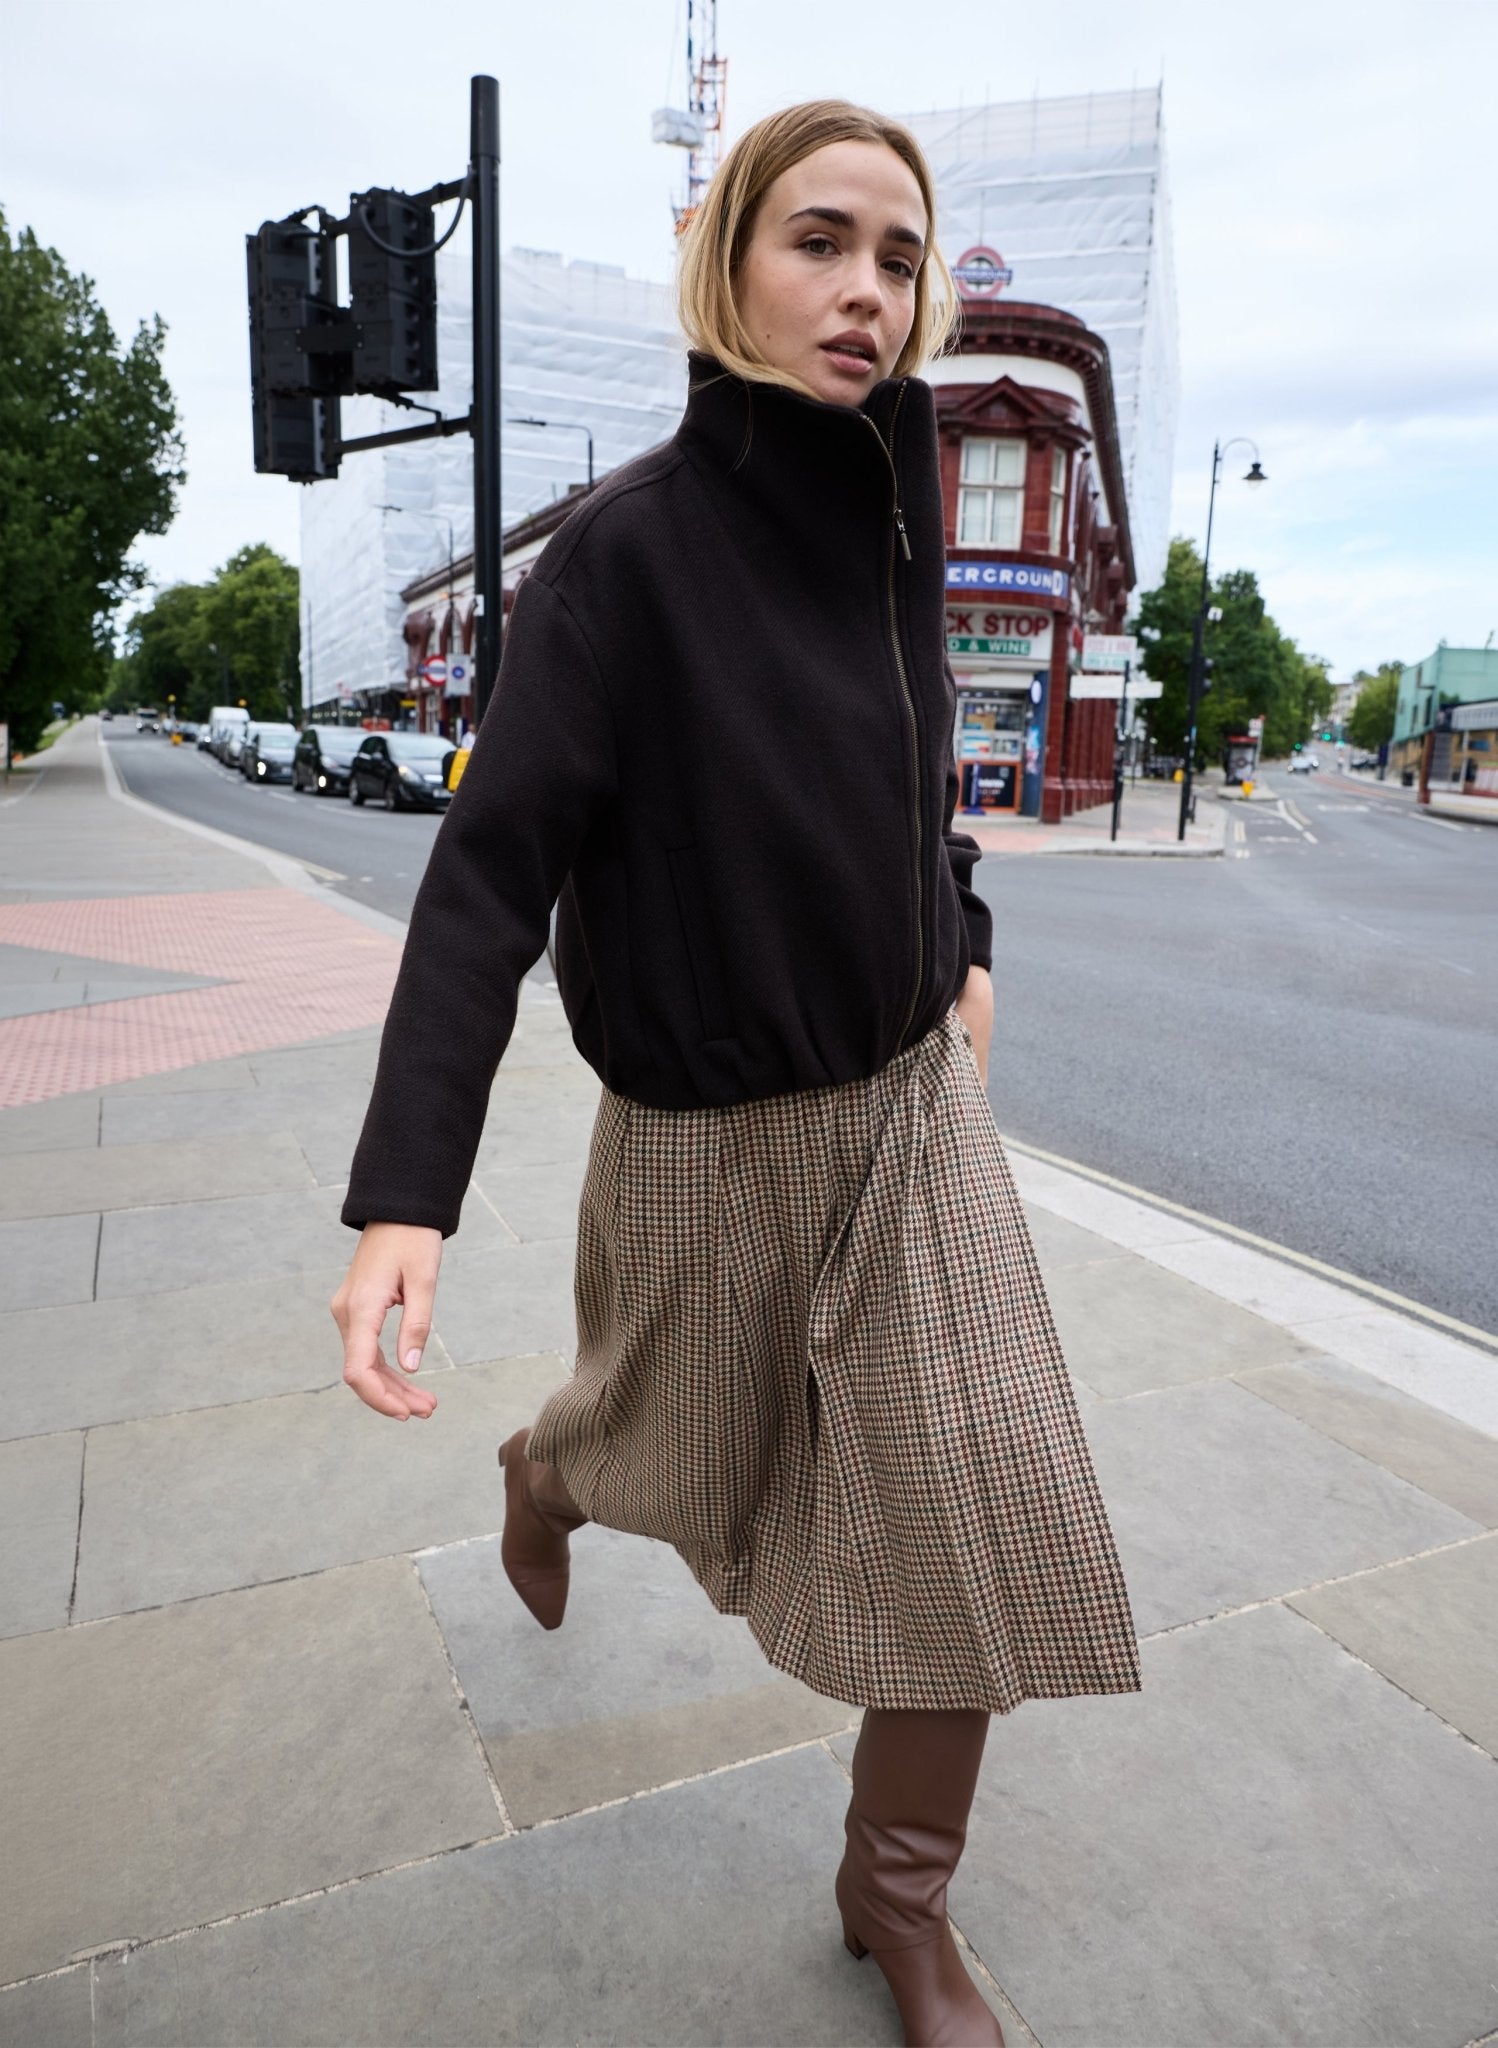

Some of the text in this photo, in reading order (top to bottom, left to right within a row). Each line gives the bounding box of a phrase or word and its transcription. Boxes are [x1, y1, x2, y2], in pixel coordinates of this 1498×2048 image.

[947, 567, 1063, 596] ERGROUND
[983, 613, 1050, 636] STOP
[988, 640, 1031, 655] WINE
